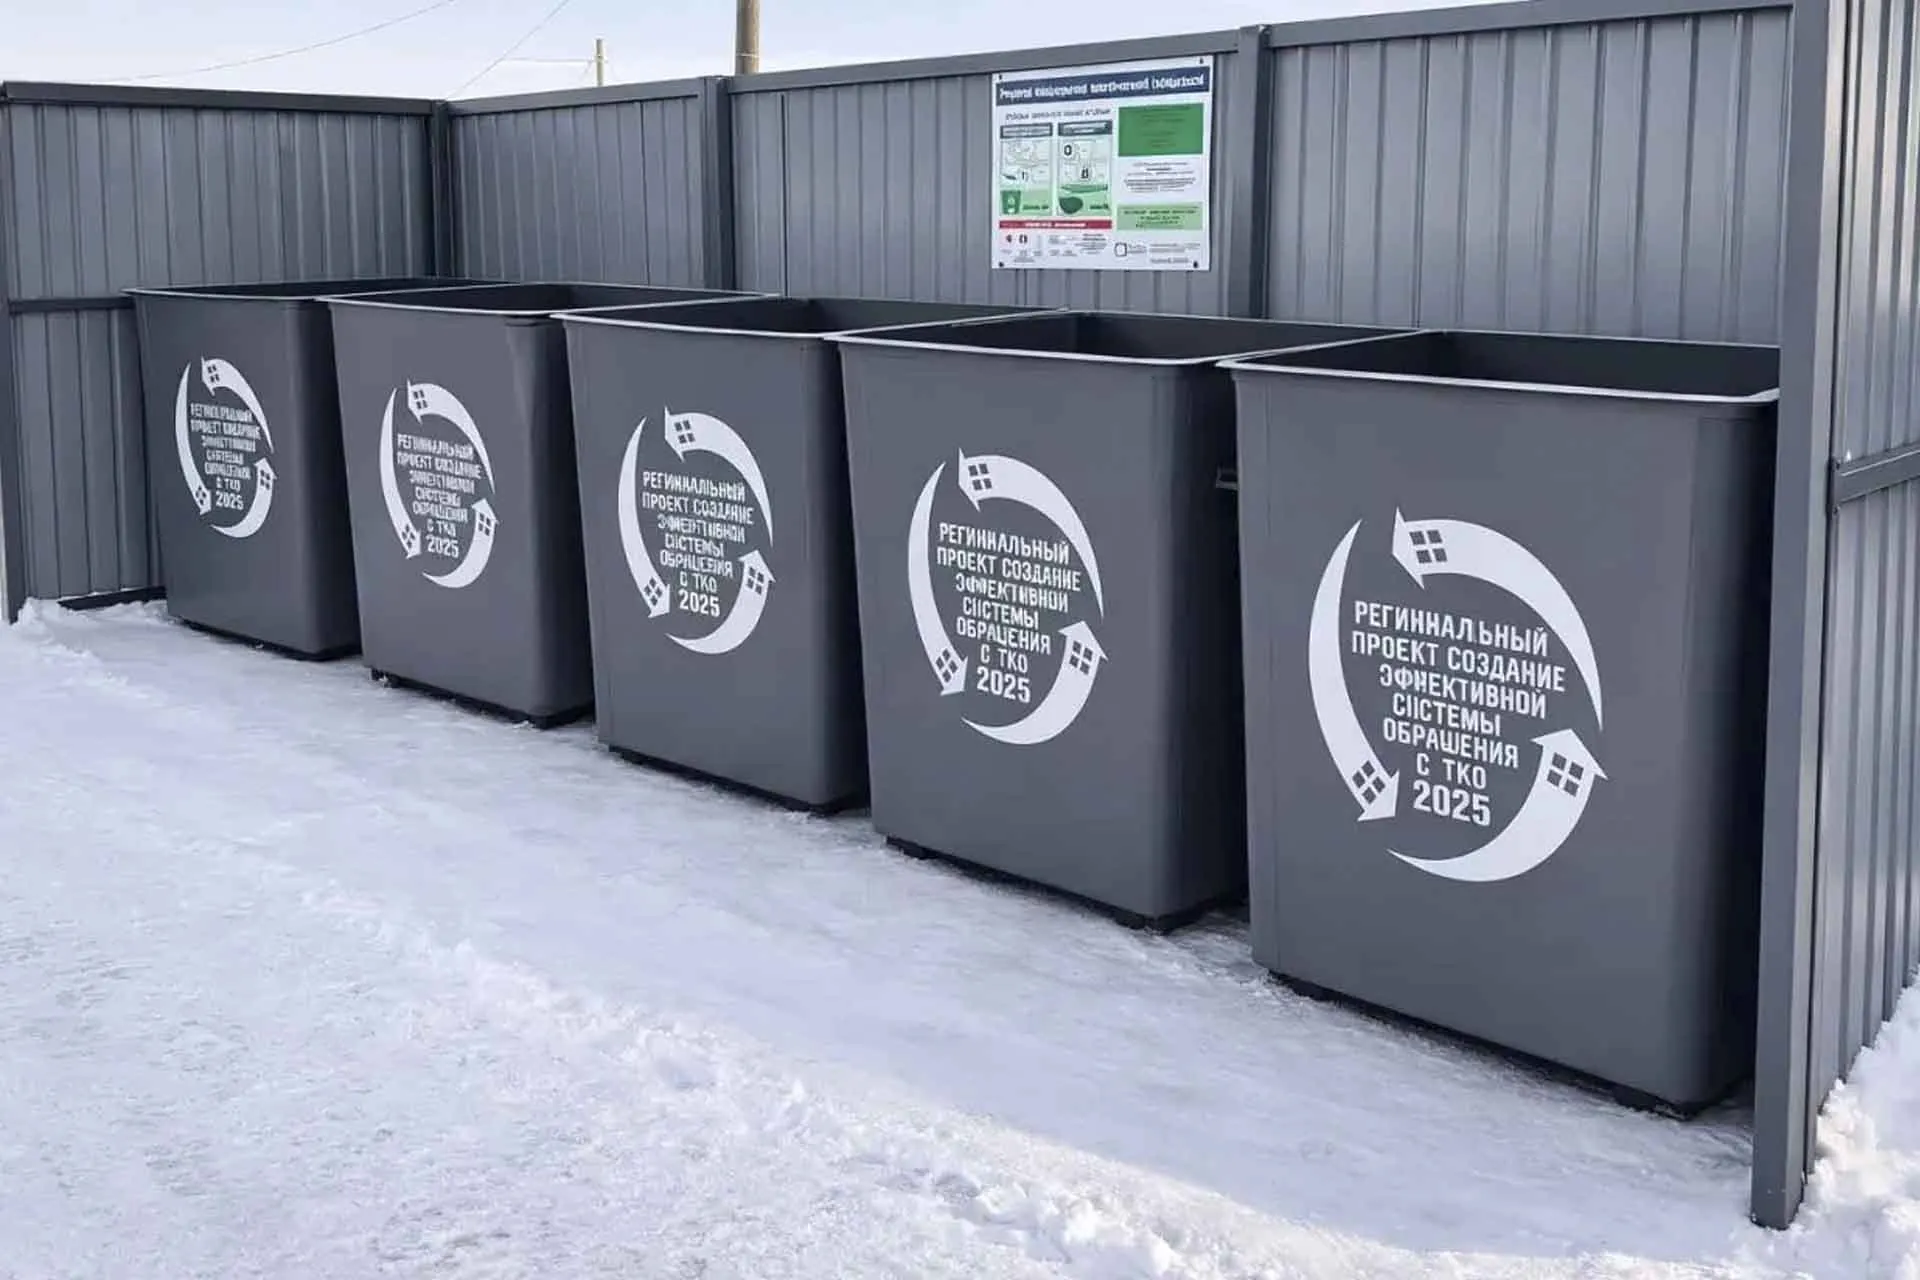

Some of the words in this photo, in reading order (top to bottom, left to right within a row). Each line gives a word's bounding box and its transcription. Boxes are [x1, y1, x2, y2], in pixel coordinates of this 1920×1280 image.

[642, 492, 689, 514] ПРОЕКТ
[426, 536, 459, 558] 2025
[694, 574, 716, 592] ТКО
[937, 547, 996, 574] ПРОЕКТ
[1002, 558, 1082, 592] СОЗДАНИЕ
[678, 592, 720, 616] 2025
[963, 597, 1039, 629] СИСТЕМЫ
[981, 645, 991, 664] С
[998, 648, 1028, 673] ТКО
[1352, 630, 1440, 666] ПРОЕКТ
[1447, 646, 1566, 692] СОЗДАНИЕ
[976, 667, 1030, 704] 2025
[1392, 694, 1502, 736] СИСТЕМЫ
[1417, 753, 1430, 776] С
[1442, 758, 1487, 790] ТКО
[1413, 781, 1491, 826] 2025
